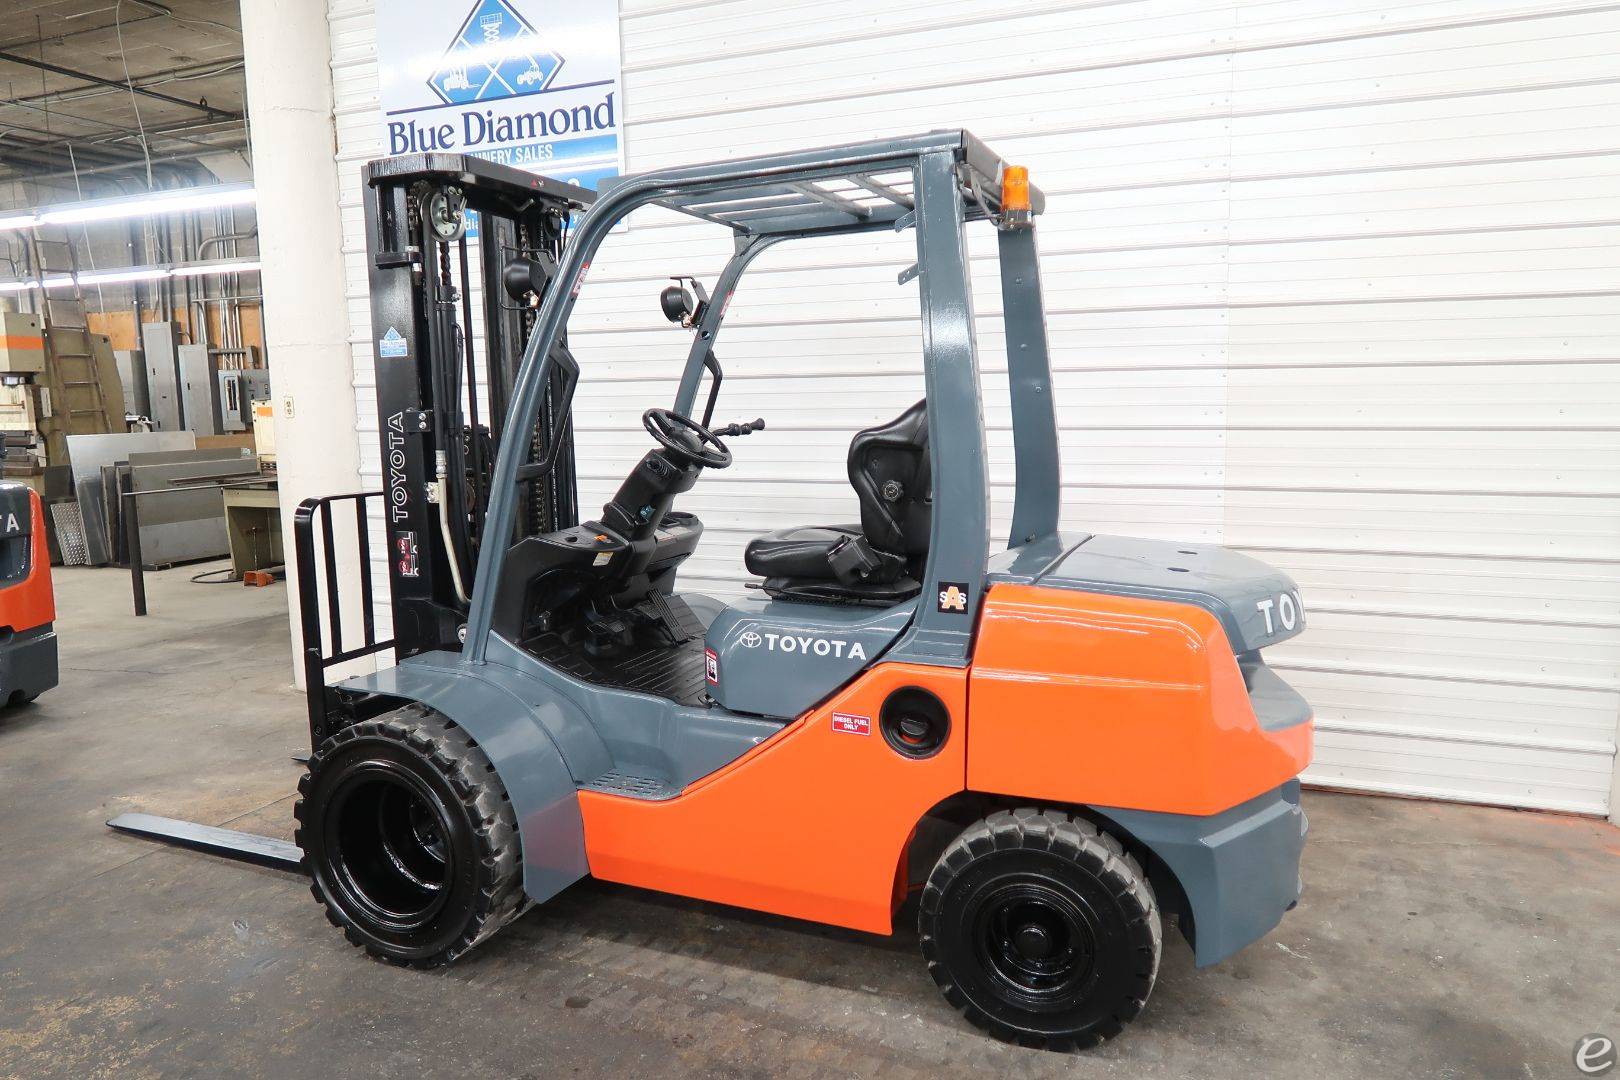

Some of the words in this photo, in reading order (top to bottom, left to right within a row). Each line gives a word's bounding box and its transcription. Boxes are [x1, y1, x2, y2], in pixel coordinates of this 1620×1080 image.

[388, 119, 455, 156] Blue
[461, 92, 616, 147] Diamond
[515, 143, 553, 163] SALES
[387, 411, 408, 523] TOYOTA
[764, 633, 867, 660] TOYOTA
[834, 715, 853, 723] DIESEL
[854, 718, 868, 726] FUEL
